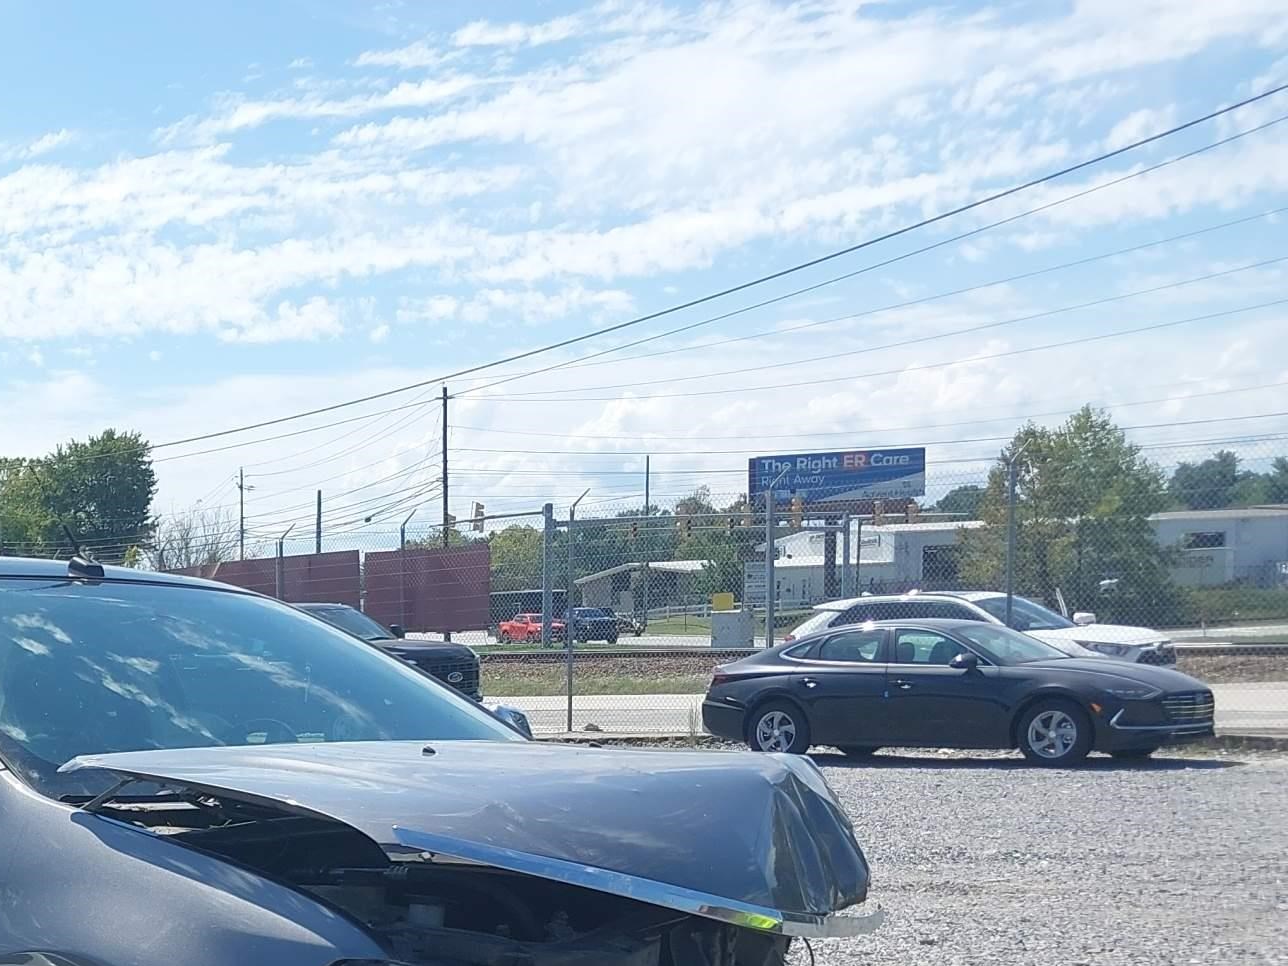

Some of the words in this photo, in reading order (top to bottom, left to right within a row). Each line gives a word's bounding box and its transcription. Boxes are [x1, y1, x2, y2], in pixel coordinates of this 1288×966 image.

[761, 459, 791, 473] The
[796, 456, 838, 474] Right
[843, 454, 866, 468] ER
[871, 453, 910, 466] Care
[794, 474, 825, 486] Away
